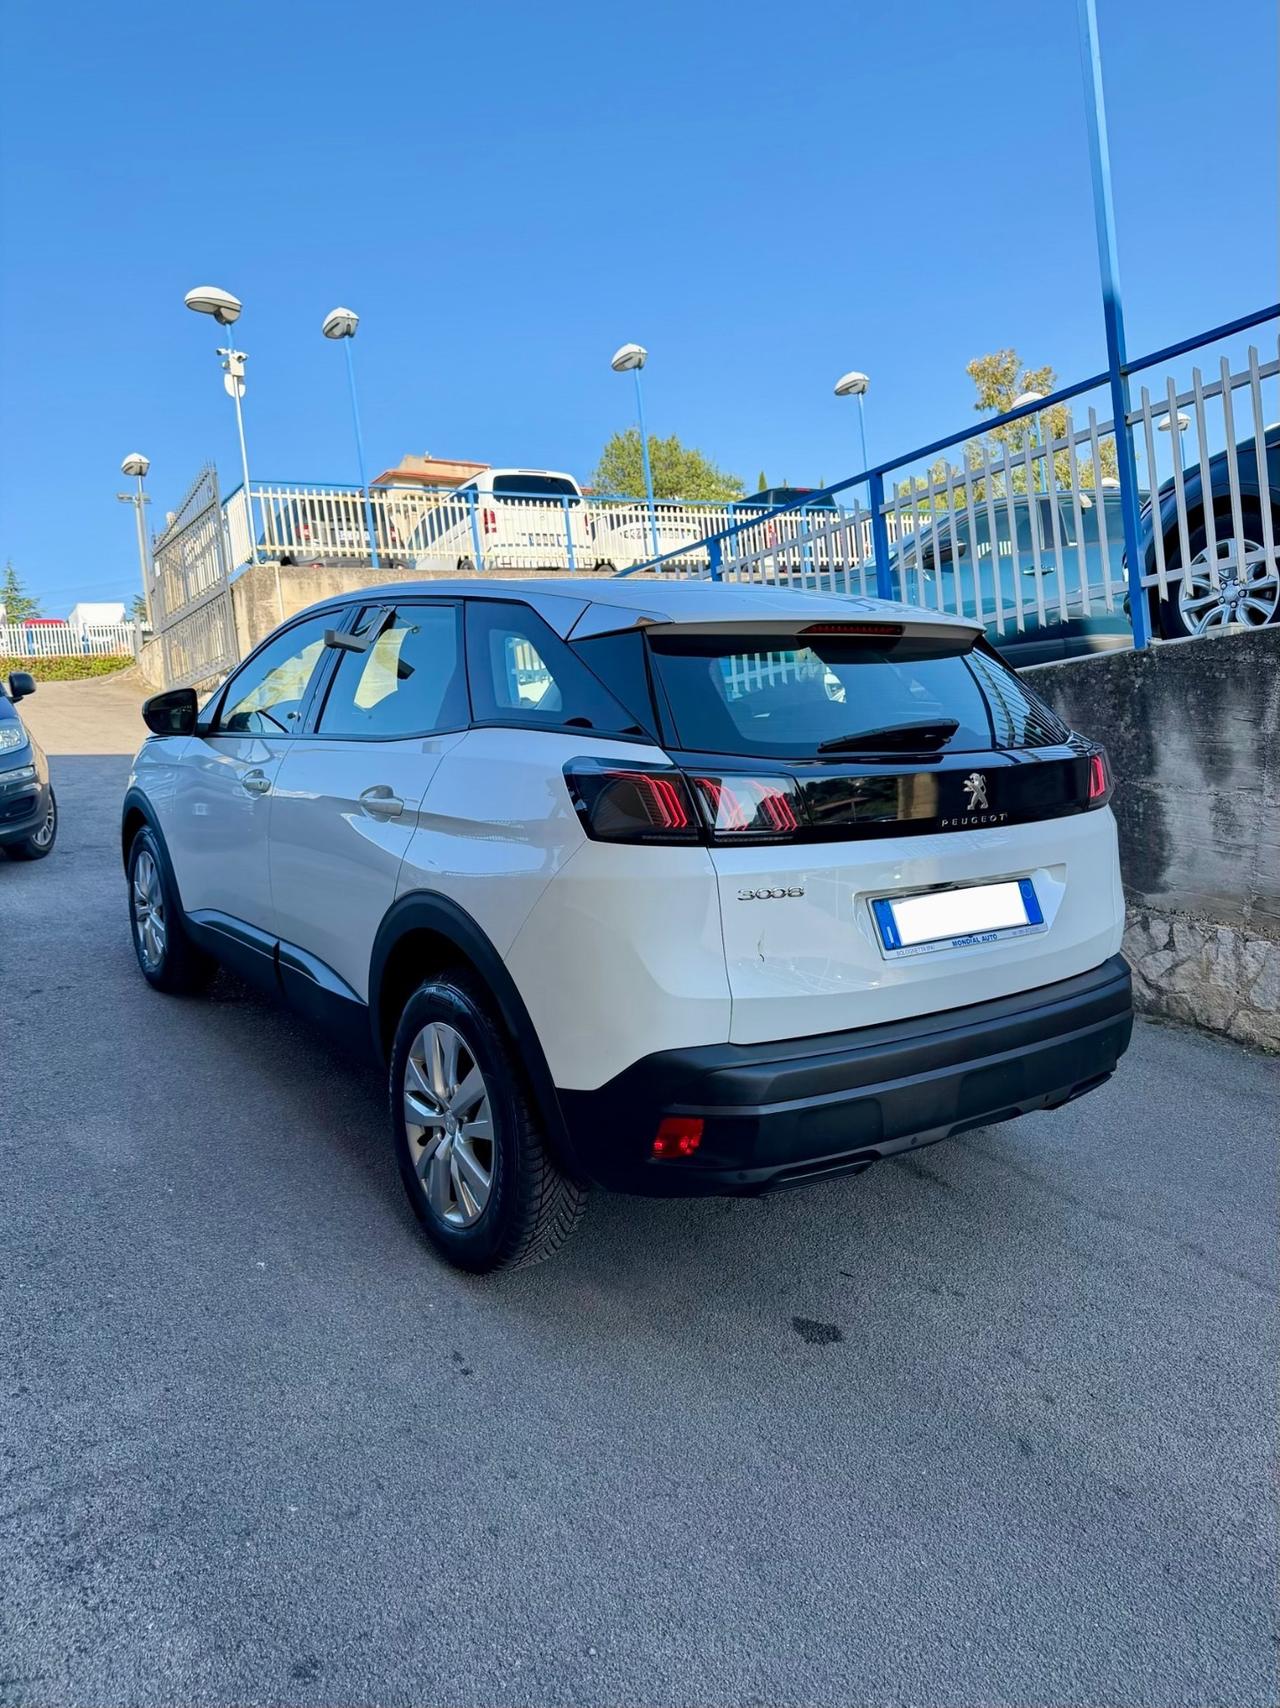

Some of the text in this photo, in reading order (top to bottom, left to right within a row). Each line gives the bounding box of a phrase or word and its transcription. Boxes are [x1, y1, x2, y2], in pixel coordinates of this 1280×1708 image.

[941, 813, 1007, 827] PEUGEOT
[737, 886, 805, 901] 3008
[951, 933, 998, 947] MONDIAL AUTO
